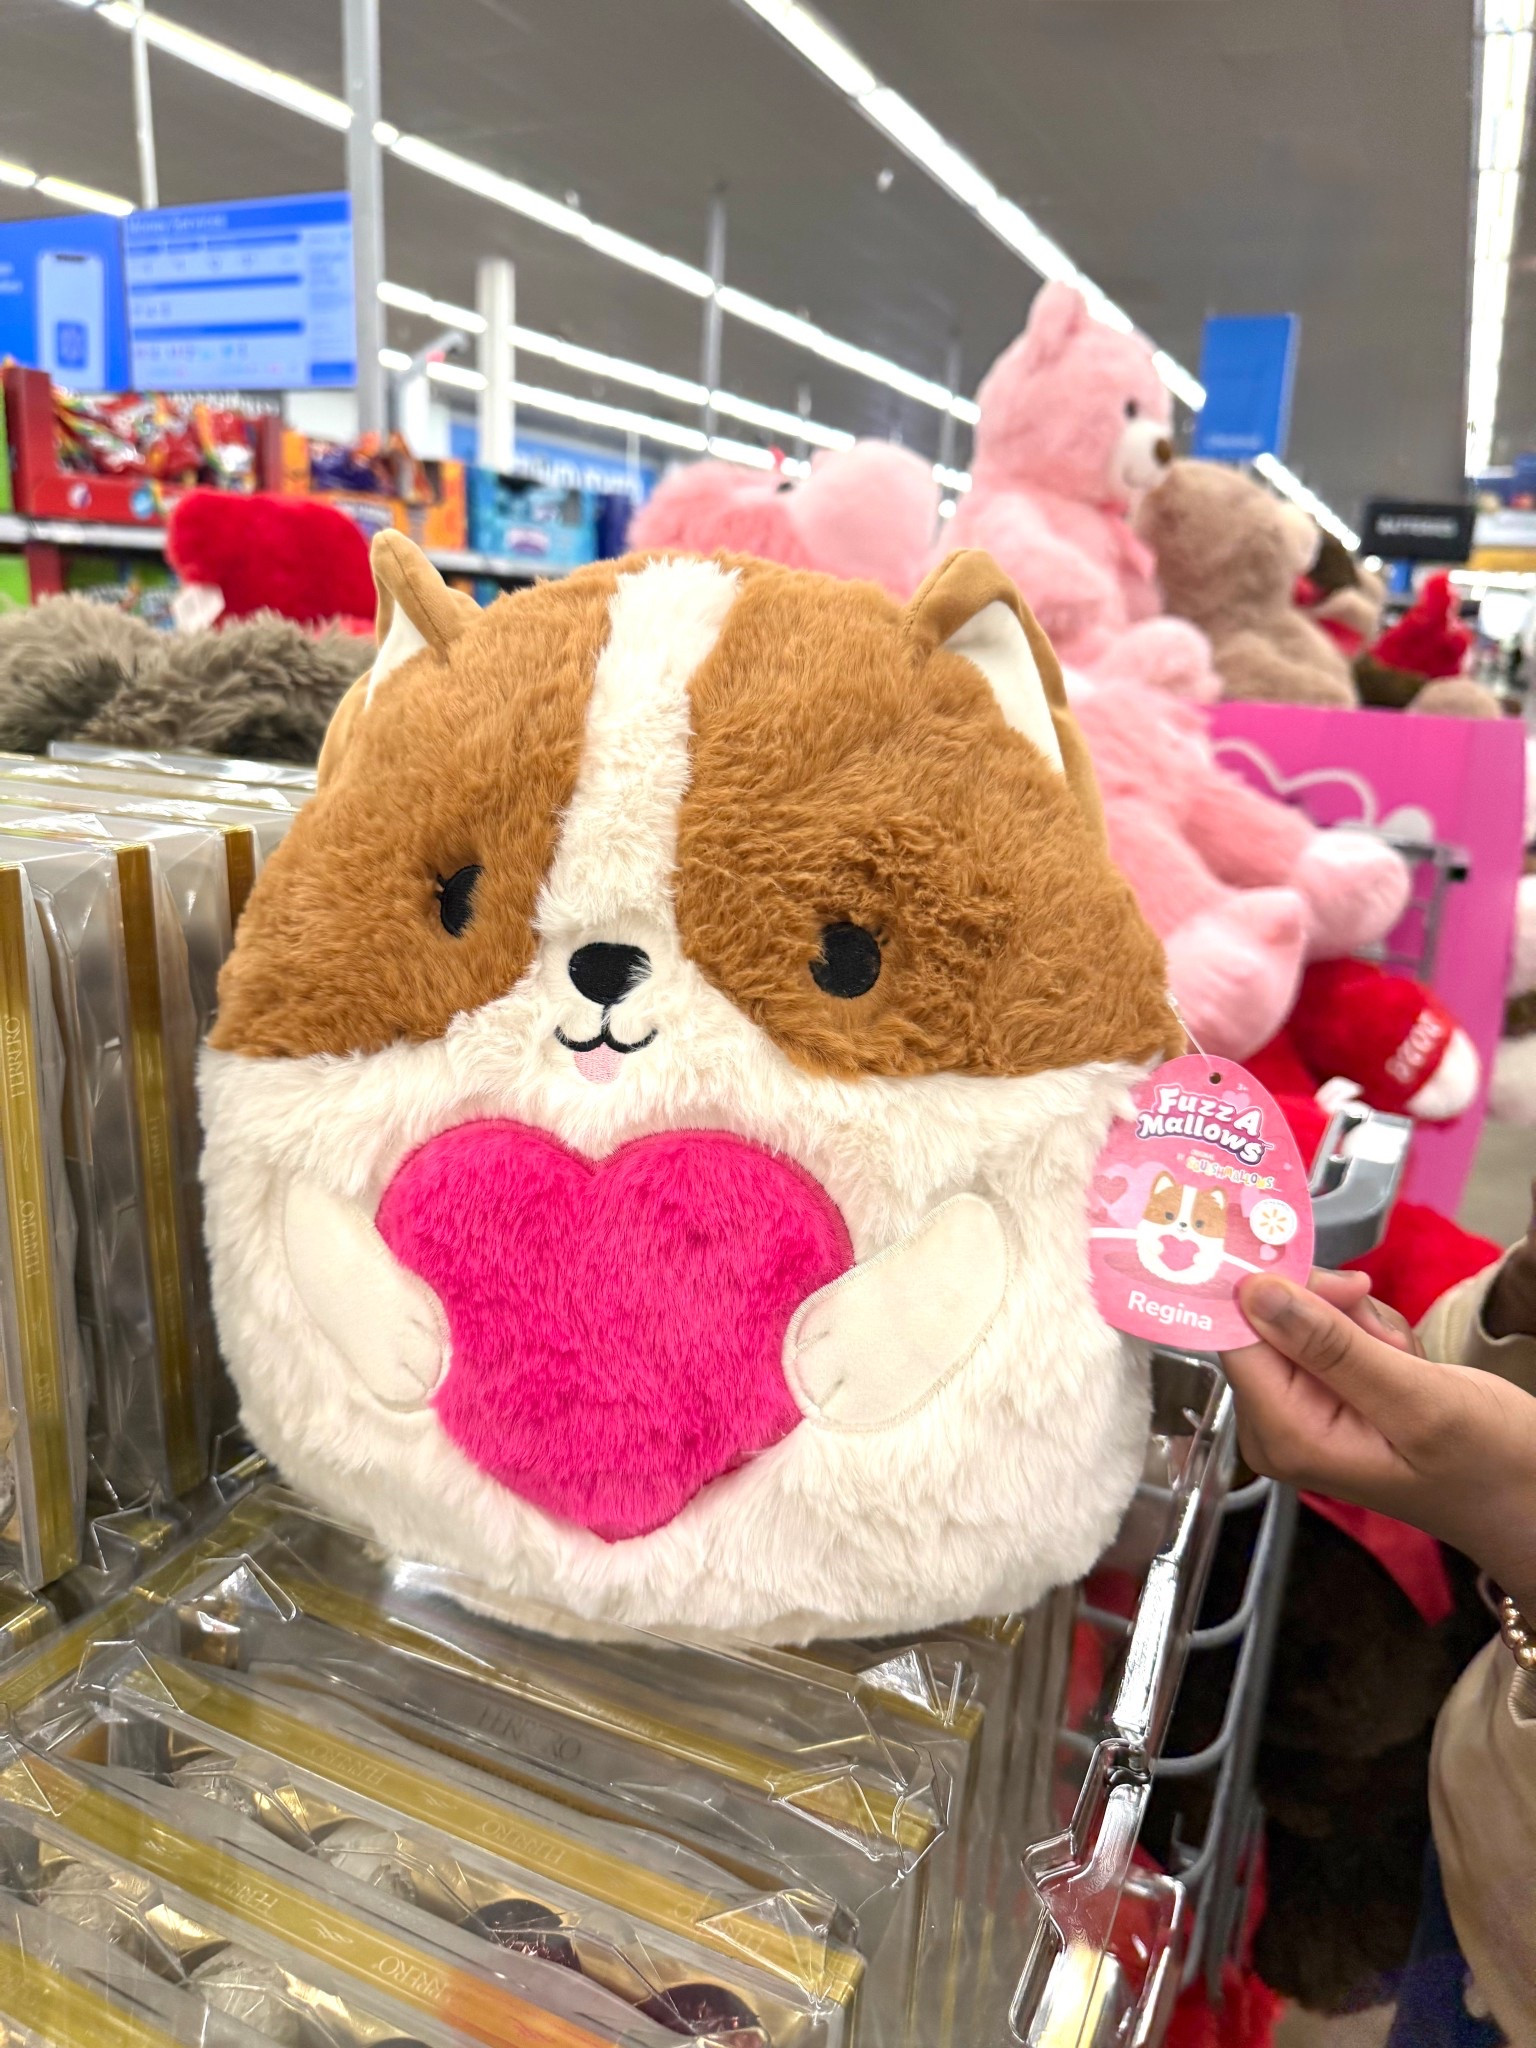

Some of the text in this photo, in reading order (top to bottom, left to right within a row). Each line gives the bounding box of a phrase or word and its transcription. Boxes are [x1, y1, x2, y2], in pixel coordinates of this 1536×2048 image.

[4, 1015, 26, 1098] FERRERO
[1127, 1289, 1214, 1332] Regina
[479, 1818, 567, 1865] FERRERO
